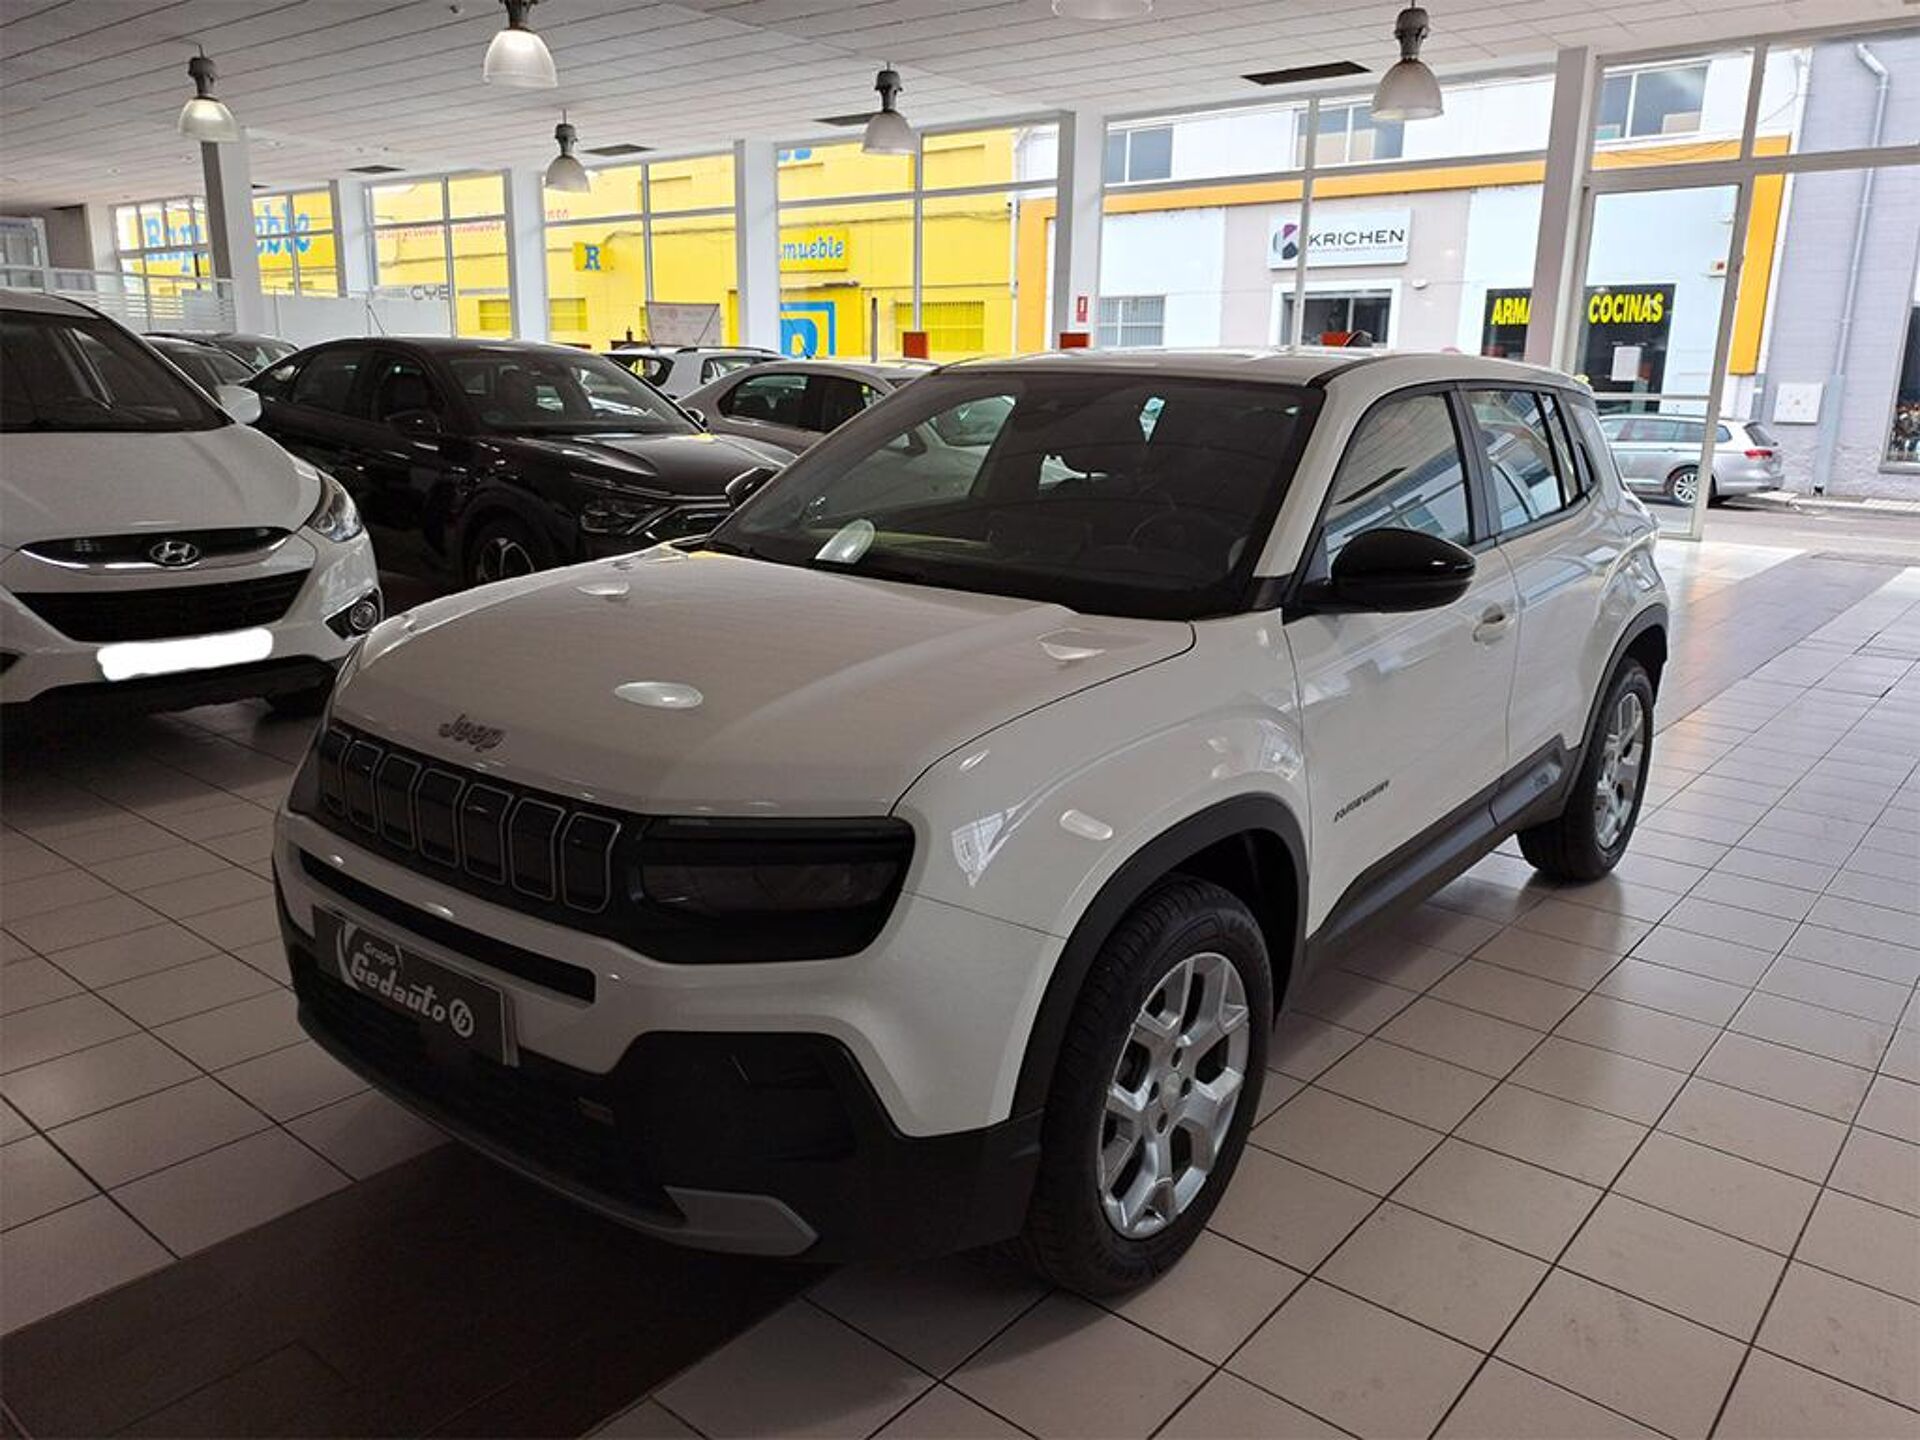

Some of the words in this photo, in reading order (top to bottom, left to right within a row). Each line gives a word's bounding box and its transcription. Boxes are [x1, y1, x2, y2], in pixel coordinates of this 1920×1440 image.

[779, 236, 844, 259] mueble
[1308, 228, 1406, 248] KRICHEN
[1587, 291, 1665, 324] COCINAS
[437, 713, 504, 753] Jeep
[350, 952, 446, 1022] Gedauto
